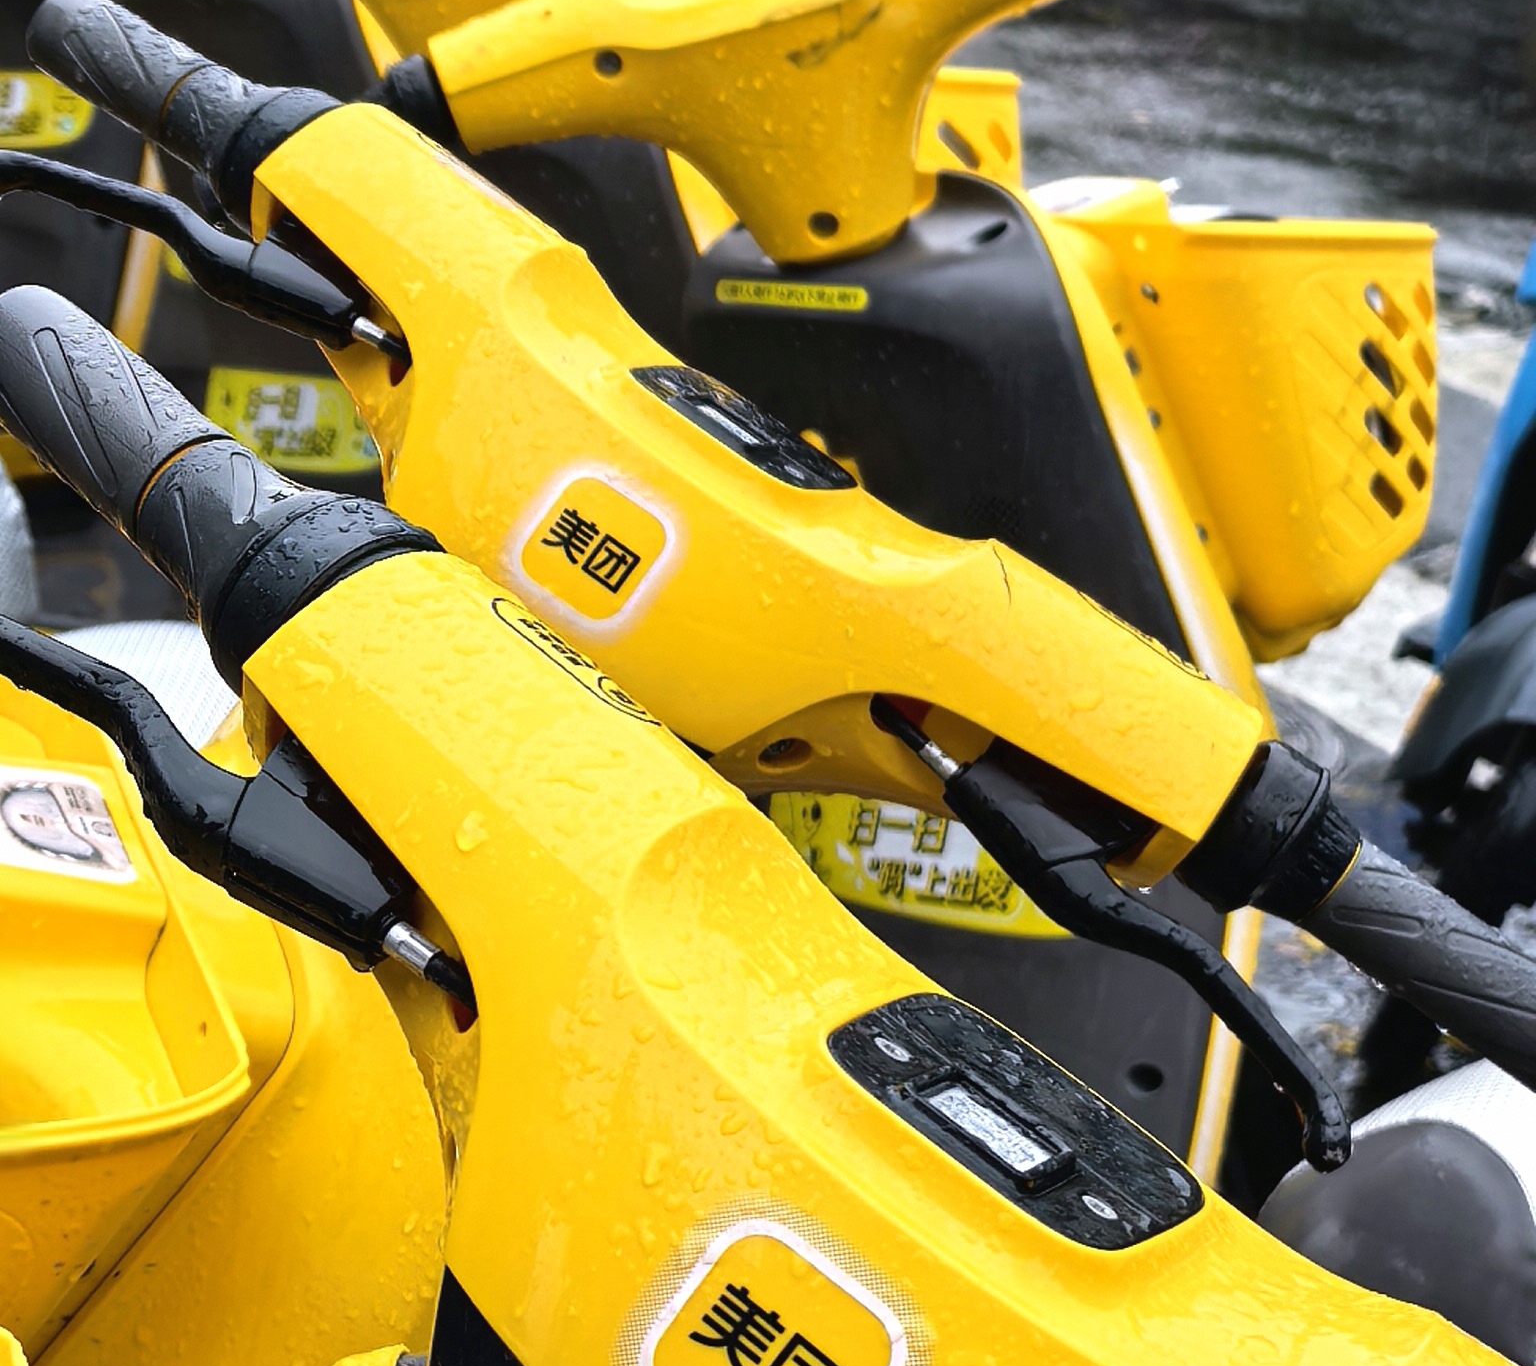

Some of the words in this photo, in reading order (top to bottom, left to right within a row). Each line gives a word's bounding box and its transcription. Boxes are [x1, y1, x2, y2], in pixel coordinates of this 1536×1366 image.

[540, 508, 641, 594] 美团
[849, 799, 948, 853] 扫一扫
